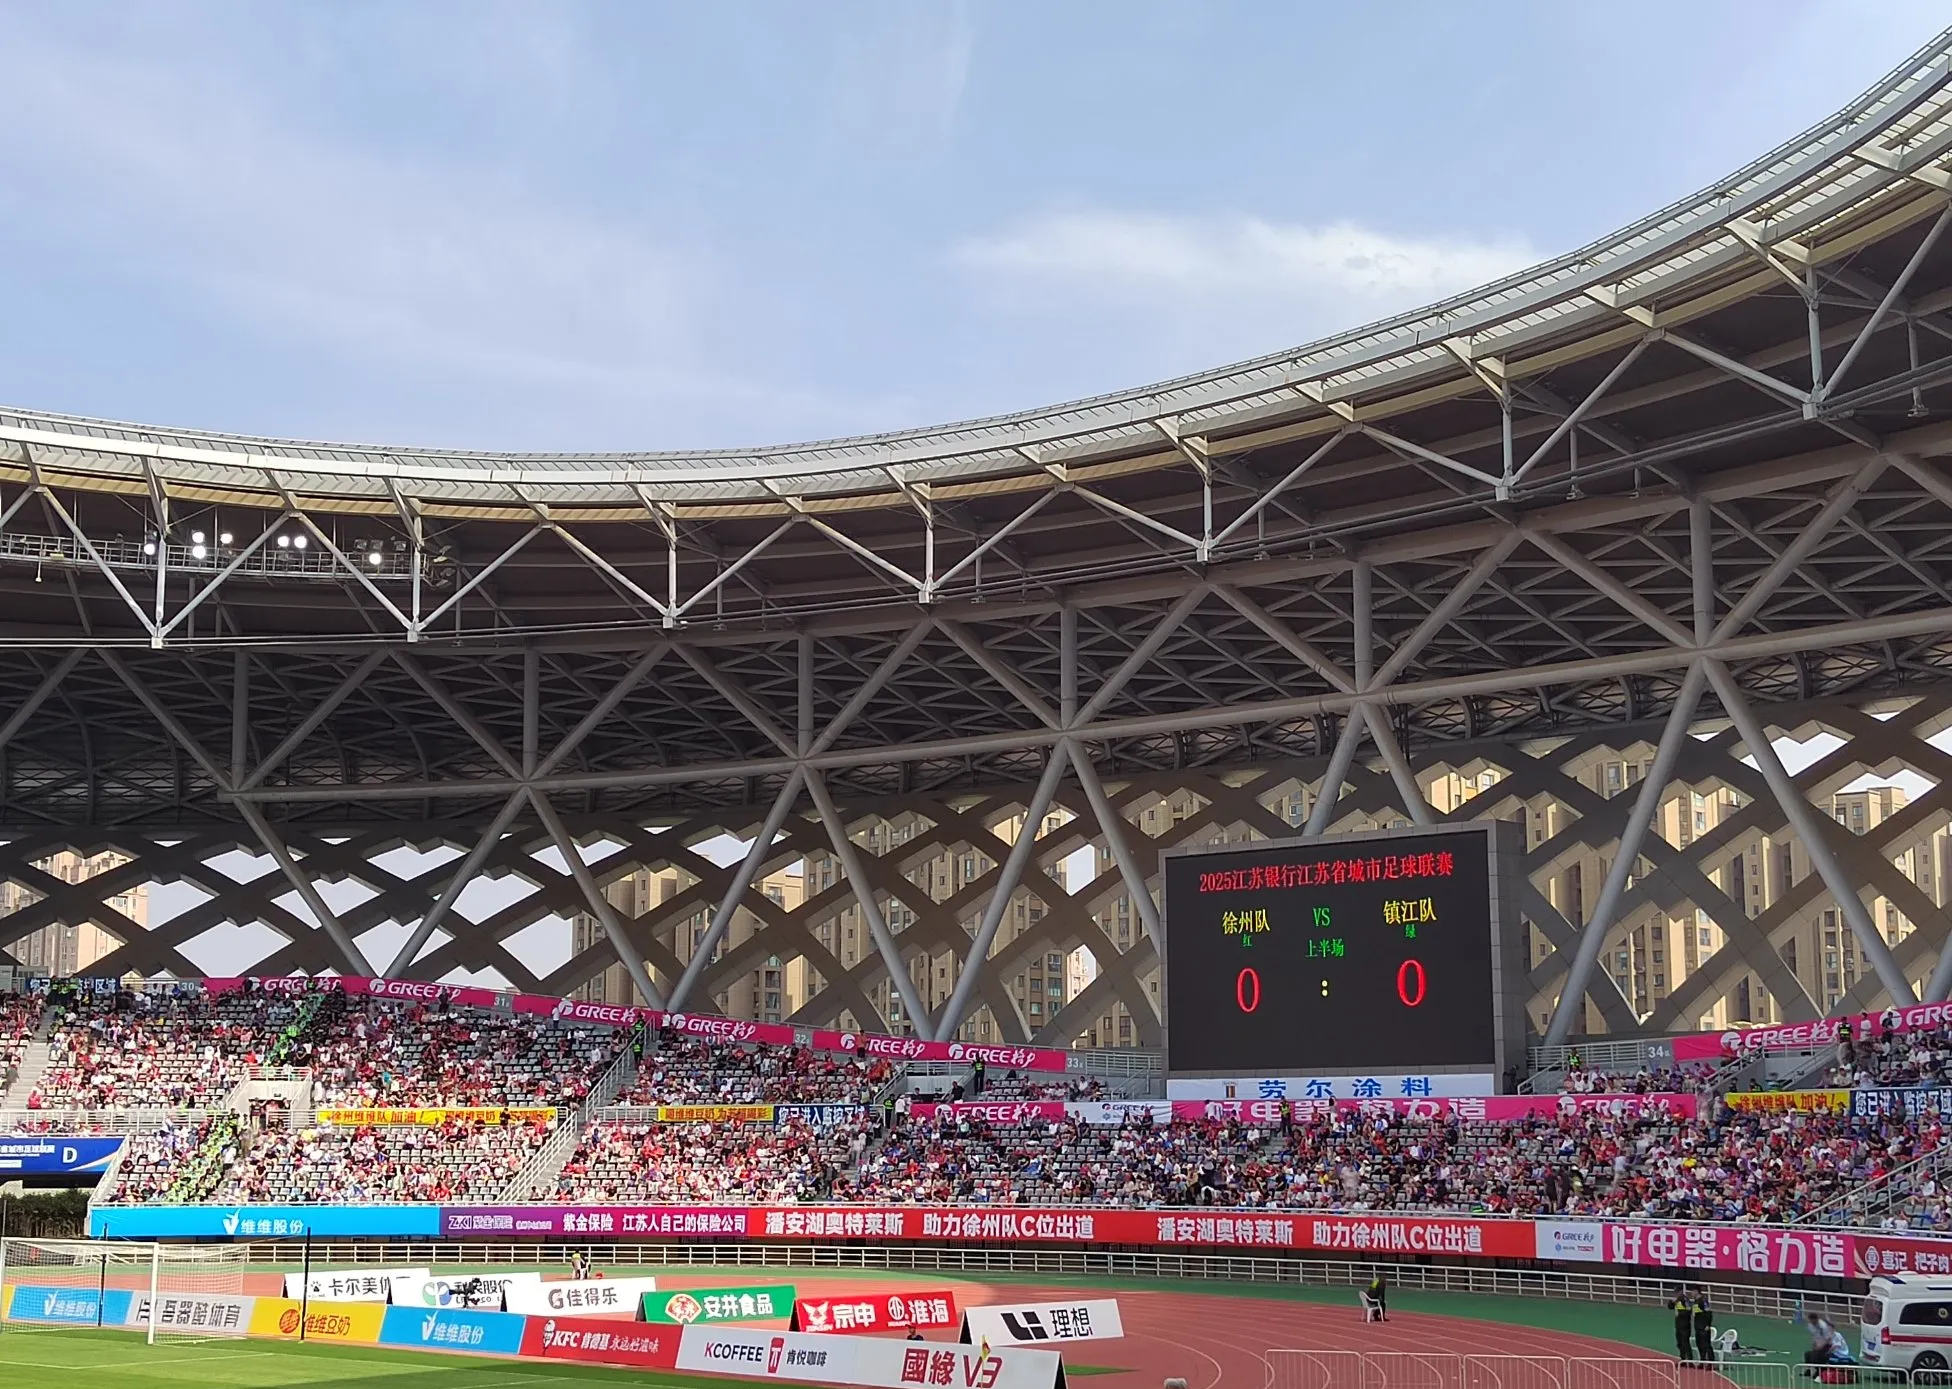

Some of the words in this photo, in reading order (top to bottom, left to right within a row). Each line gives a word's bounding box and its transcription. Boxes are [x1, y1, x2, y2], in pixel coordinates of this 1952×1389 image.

[1200, 852, 1453, 892] 2025江苏银行江苏省城市足球联赛
[1222, 908, 1270, 934] 徐州队
[1312, 908, 1331, 928] VS
[1384, 897, 1436, 924] 镇江队
[1242, 934, 1253, 948] 红
[1404, 924, 1416, 939] 绿
[1305, 938, 1344, 958] 上半场
[1236, 966, 1261, 1013] 0
[1396, 958, 1427, 1008] 0
[1259, 1077, 1432, 1099] 劳尔涂料
[1855, 1089, 1952, 1116] 您已进监控区域
[62, 1146, 78, 1163] D
[241, 1218, 304, 1235] 维维股份
[563, 1212, 614, 1233] 紫金保险
[622, 1212, 746, 1234] 江苏人自己的保险公司
[765, 1211, 904, 1237] 潘安湖奥特莱斯
[922, 1212, 1094, 1240] 助力徐州队C位出道
[1157, 1216, 1293, 1246] 潘安湖奥特莱斯
[1312, 1220, 1483, 1253] 助力徐州队C位出道
[1611, 1225, 1846, 1278] 好电器·格力造
[1881, 1250, 1908, 1271] 喜记
[566, 1286, 618, 1308] 佳得乐
[703, 1293, 774, 1320] 安井食品
[303, 1312, 351, 1336] 维维豆奶
[831, 1302, 876, 1328] 宗申
[907, 1298, 949, 1325] 淮海
[1049, 1307, 1094, 1338] 理想
[432, 1322, 484, 1345] 维维股份
[552, 1330, 580, 1348] KFC
[580, 1332, 611, 1350] 肯德基
[609, 1334, 660, 1354] 永远好滋味
[703, 1341, 764, 1362] KCOFFEE
[786, 1349, 827, 1367] 肯悦咖啡
[901, 1347, 956, 1386] 國緣
